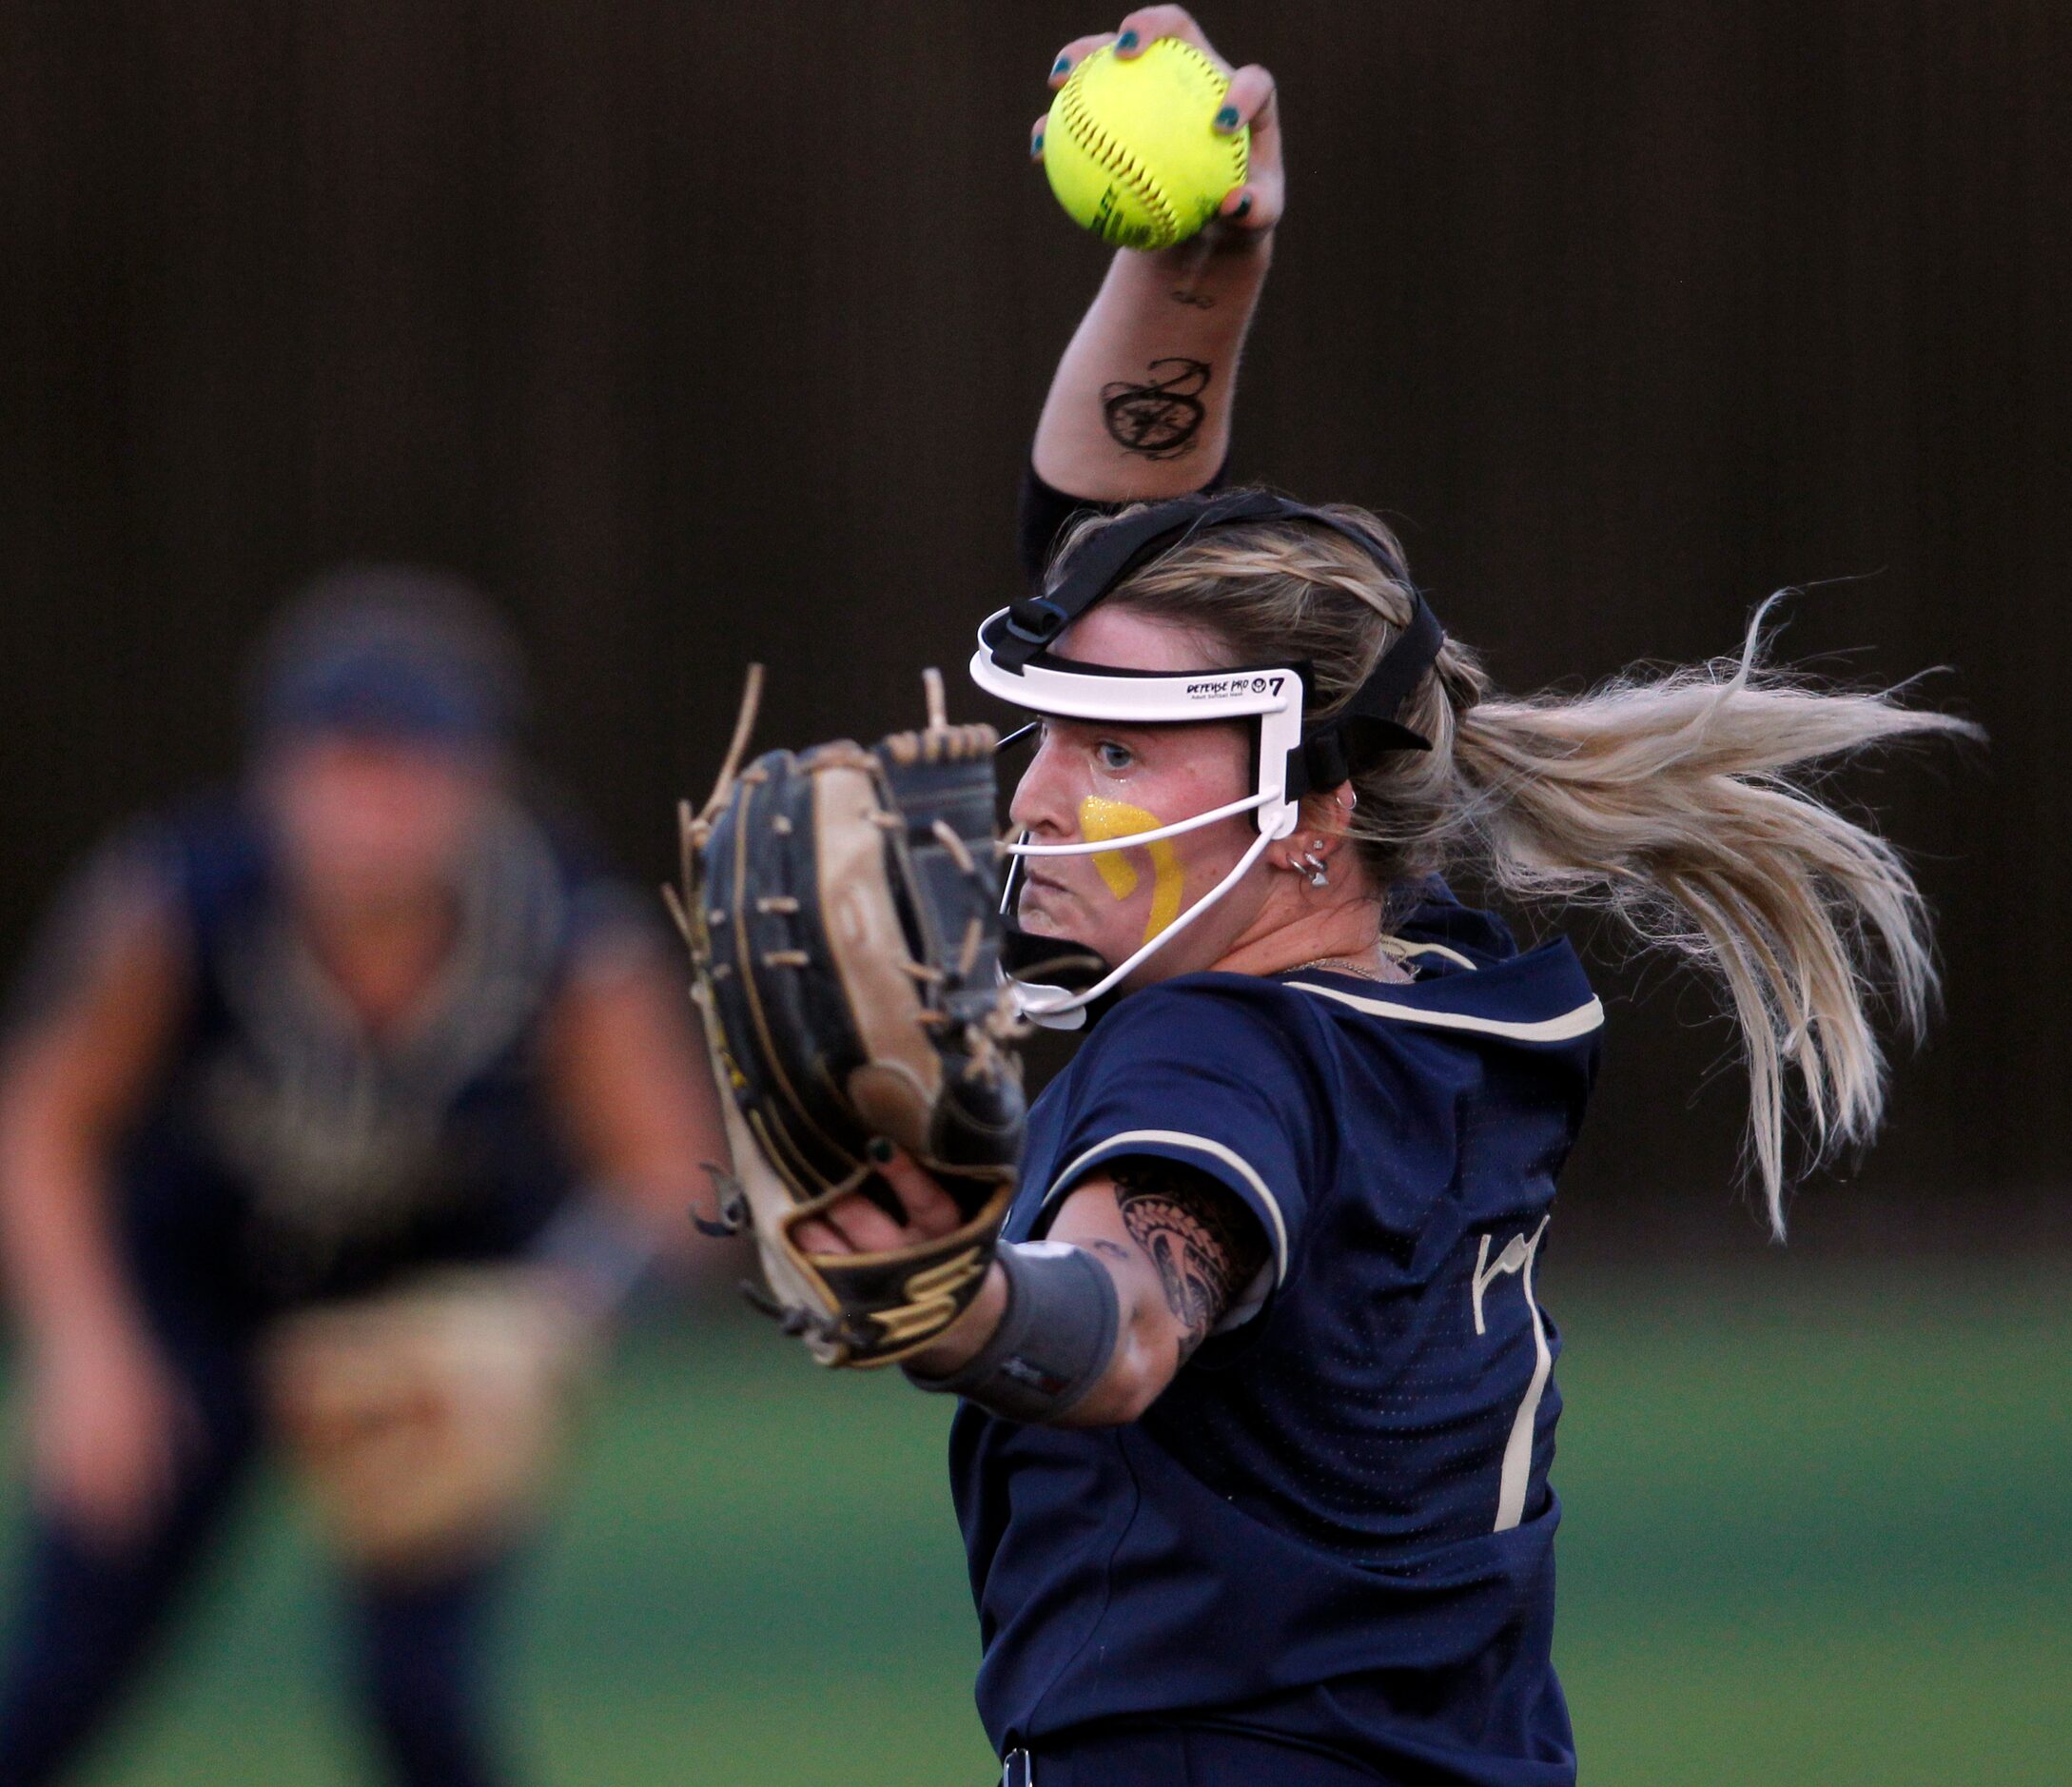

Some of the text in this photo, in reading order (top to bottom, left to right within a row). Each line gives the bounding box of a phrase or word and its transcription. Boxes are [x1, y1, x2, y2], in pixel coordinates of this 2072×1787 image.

[1186, 679, 1249, 694] DEFENSE PRO
[1269, 677, 1285, 697] 7
